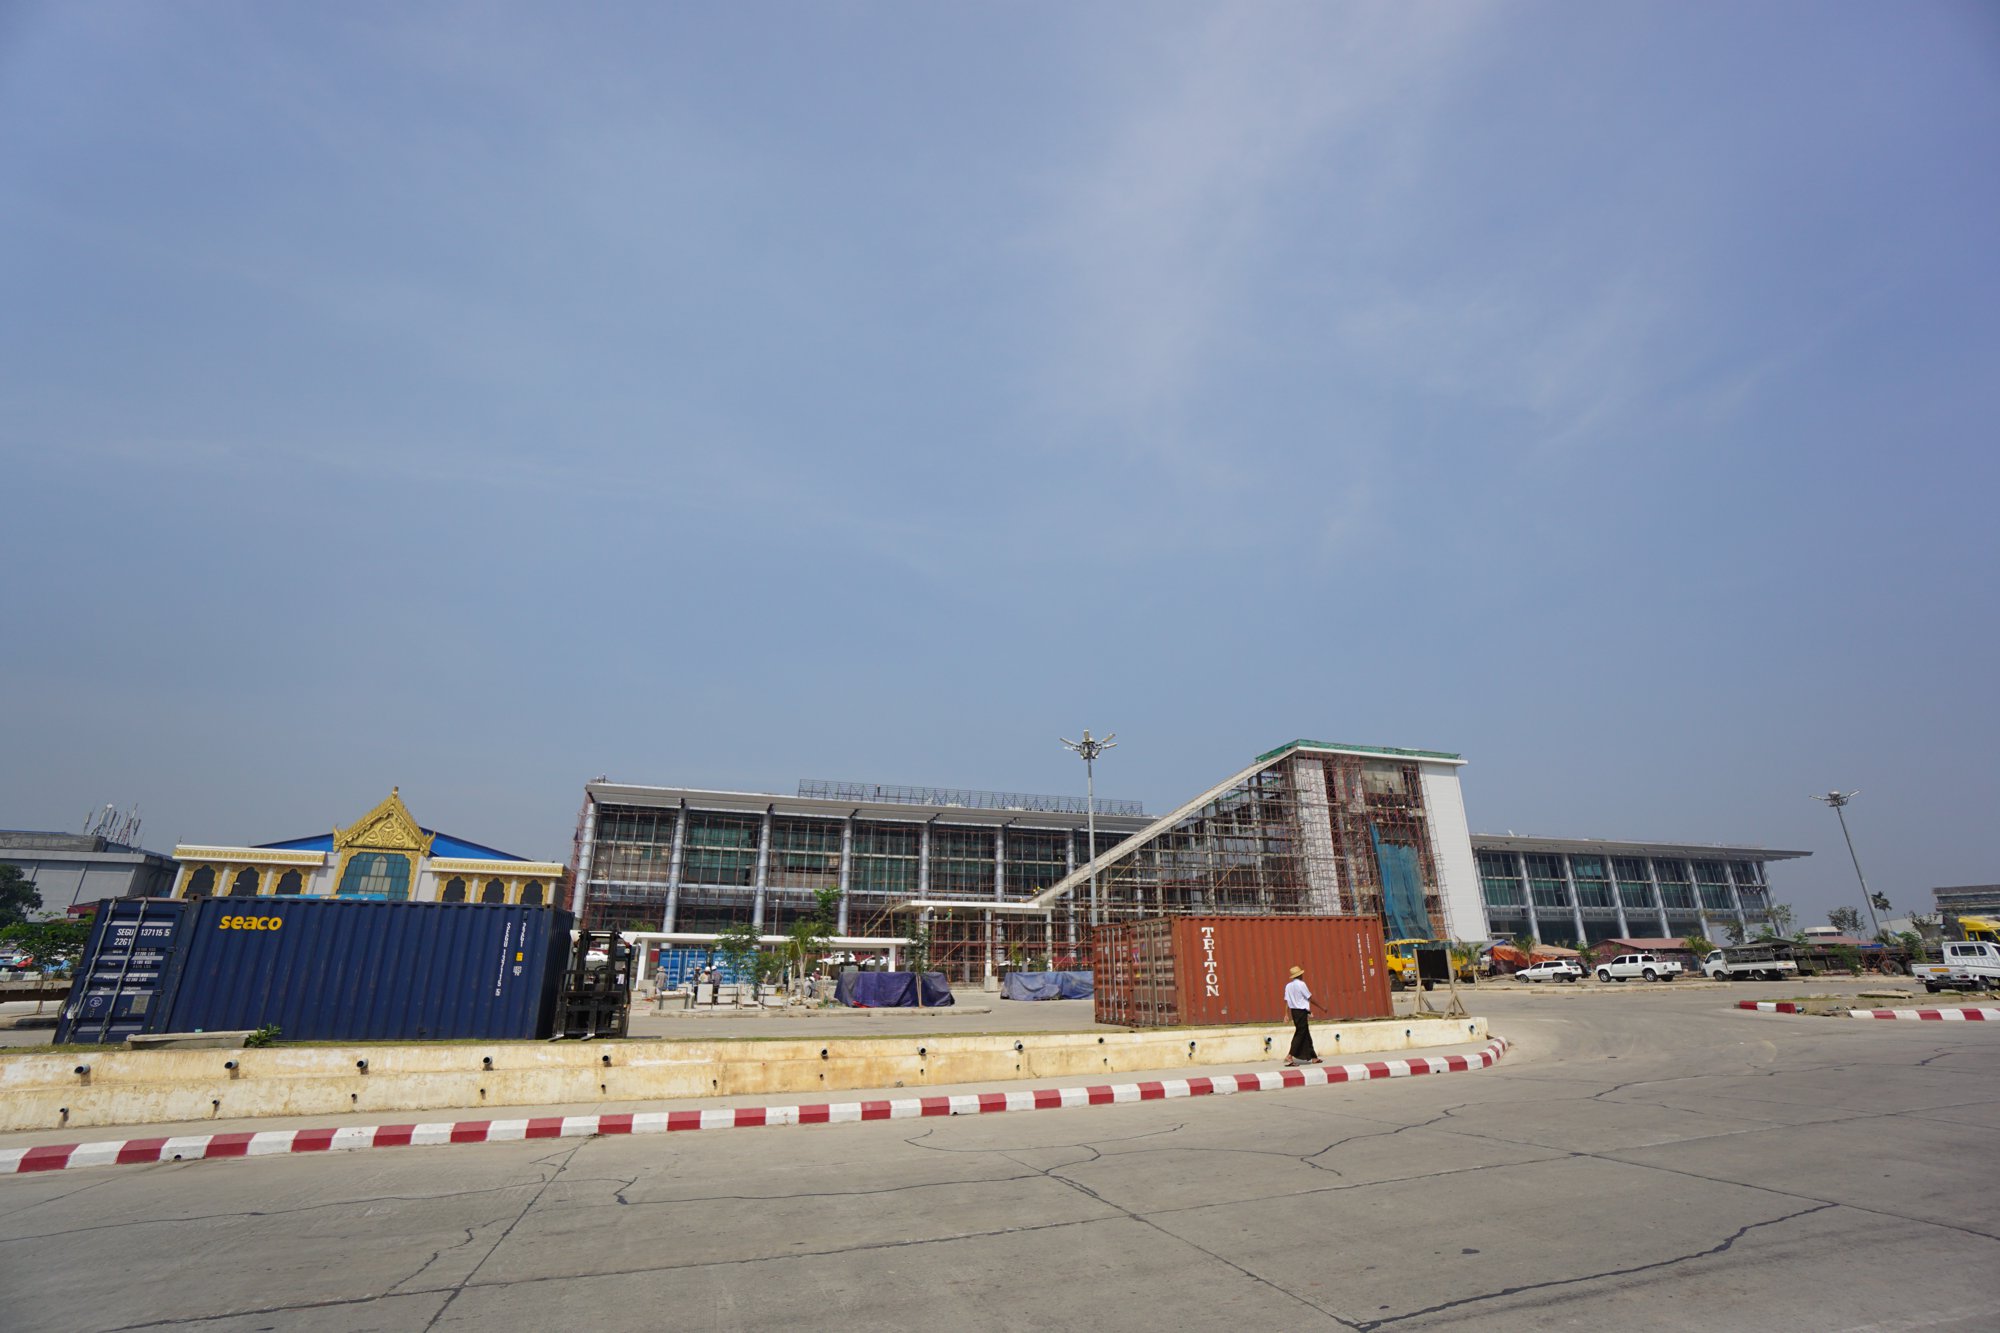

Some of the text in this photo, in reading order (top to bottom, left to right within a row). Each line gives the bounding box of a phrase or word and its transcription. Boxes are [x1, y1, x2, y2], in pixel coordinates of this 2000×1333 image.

[219, 915, 283, 931] seaco
[117, 928, 135, 936] SEGU
[1201, 926, 1220, 997] TRITON
